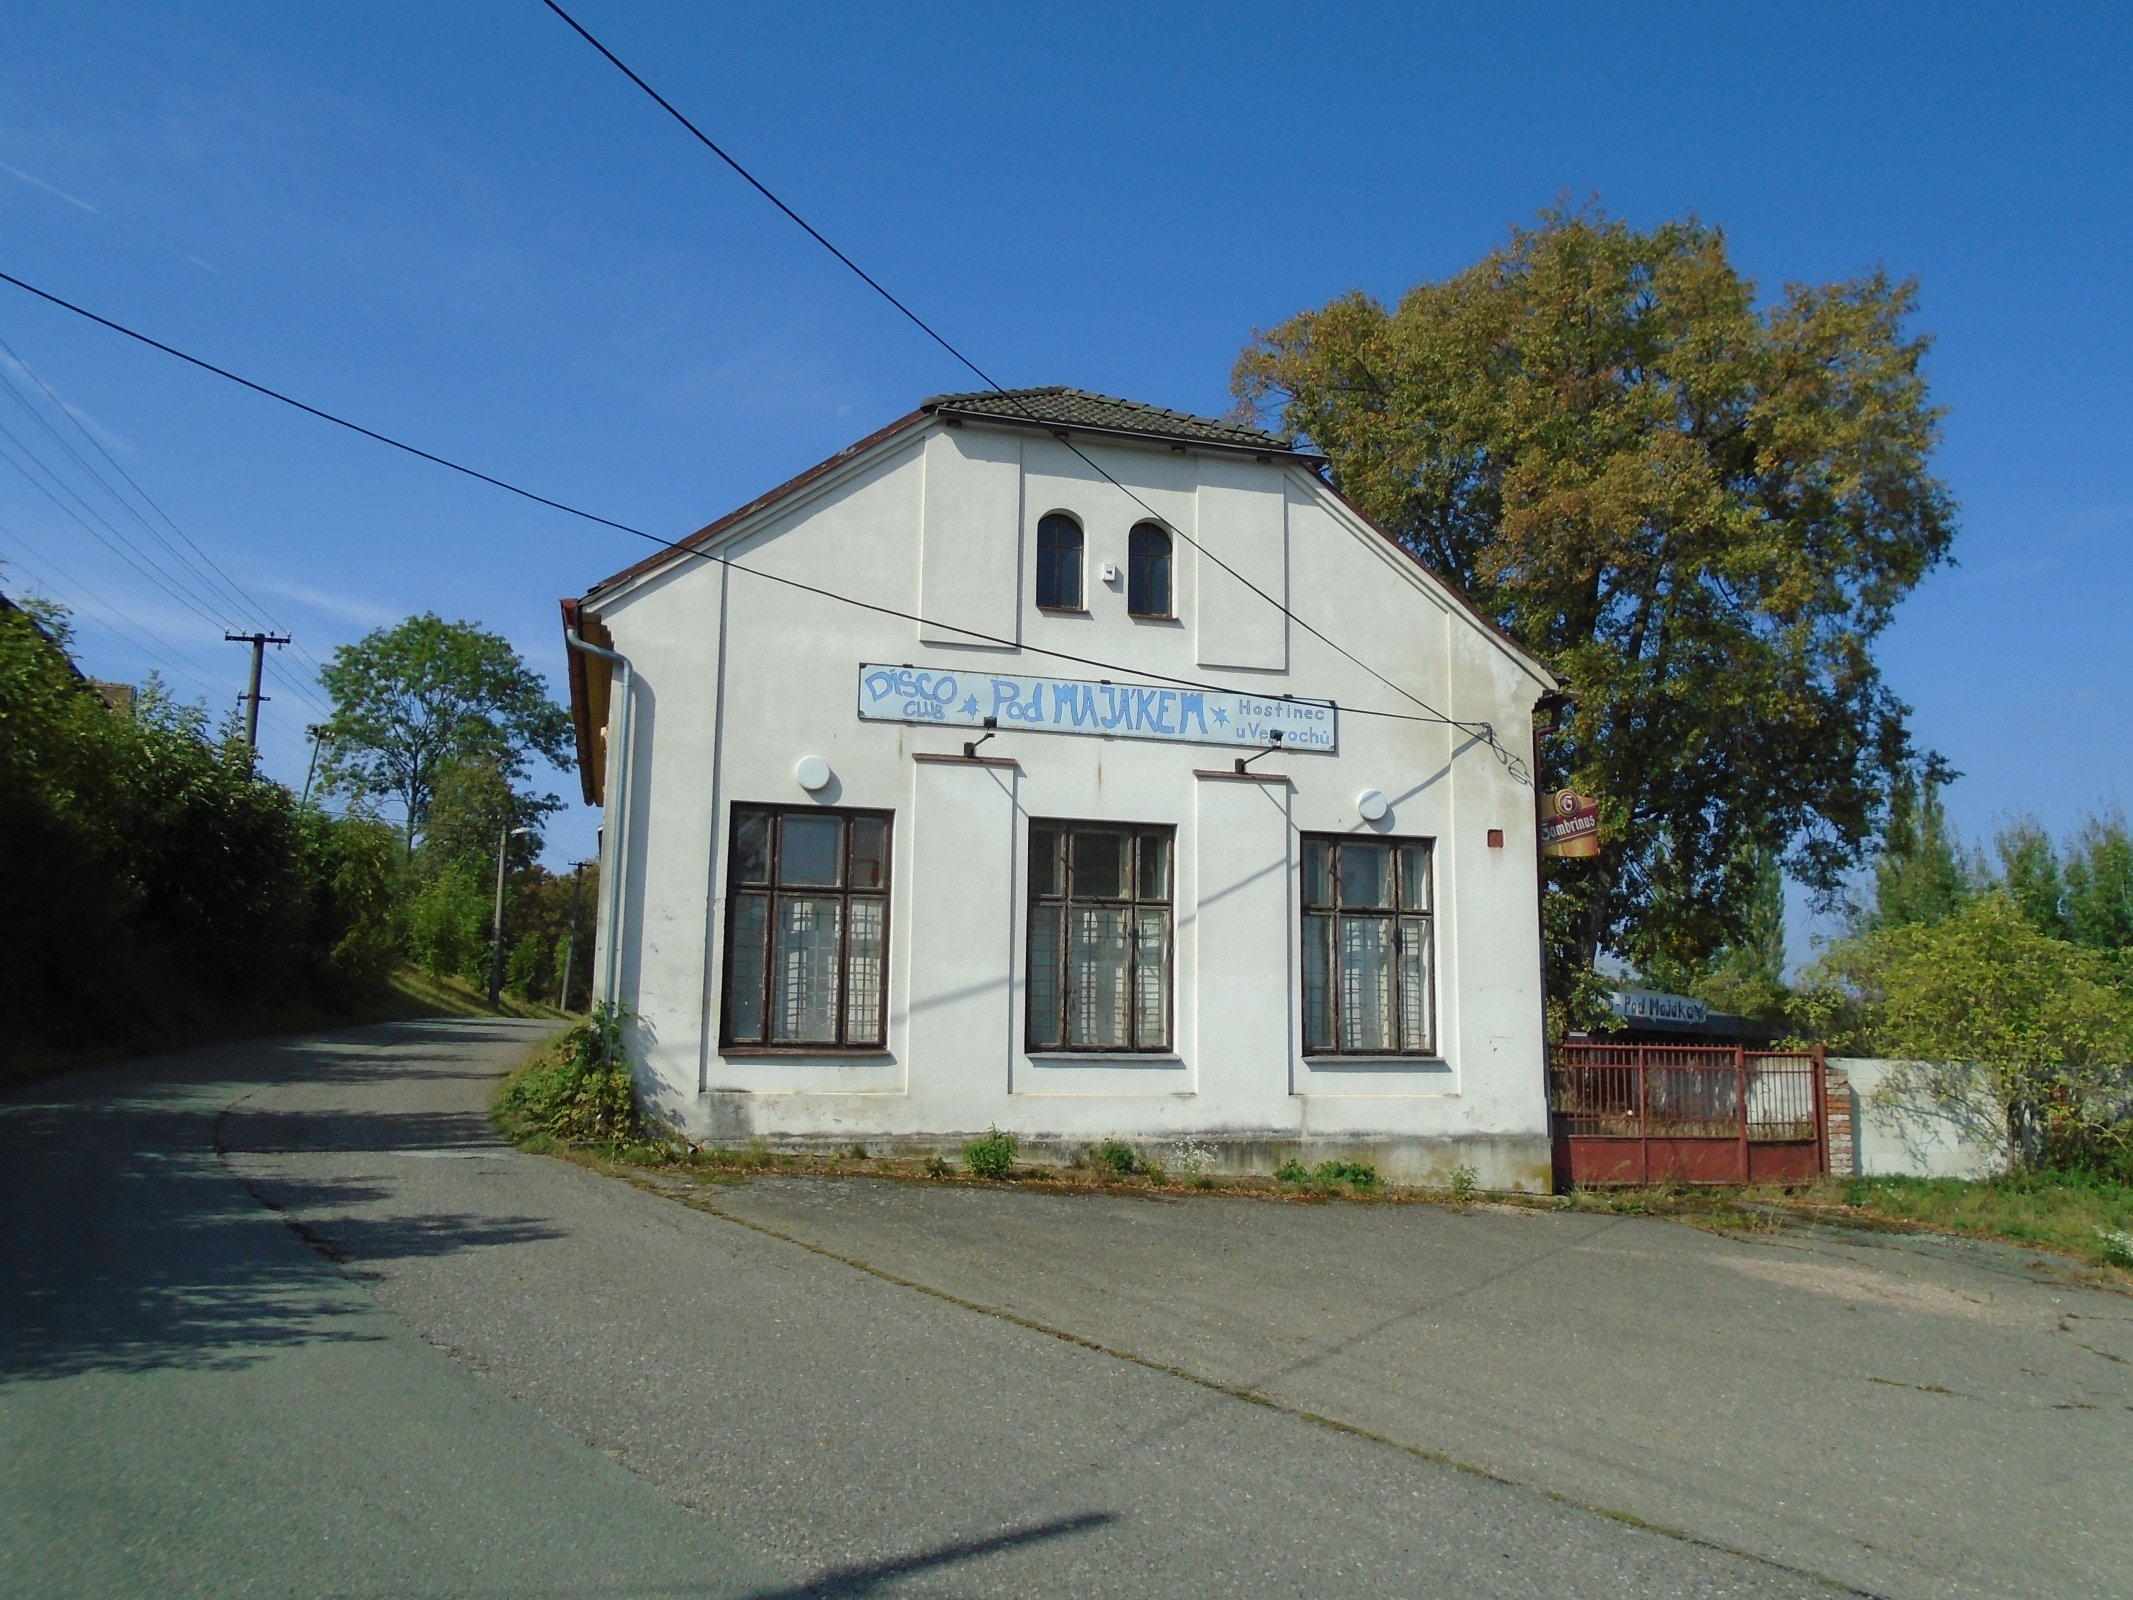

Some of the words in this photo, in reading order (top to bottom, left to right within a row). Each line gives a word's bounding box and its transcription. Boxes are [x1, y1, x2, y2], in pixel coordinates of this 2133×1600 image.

[903, 701, 945, 720] CLUB
[991, 679, 1044, 722] Pod
[1239, 699, 1325, 720] Hostinec
[1541, 815, 1596, 840] Gambrinus
[1624, 995, 1645, 1014] Pod
